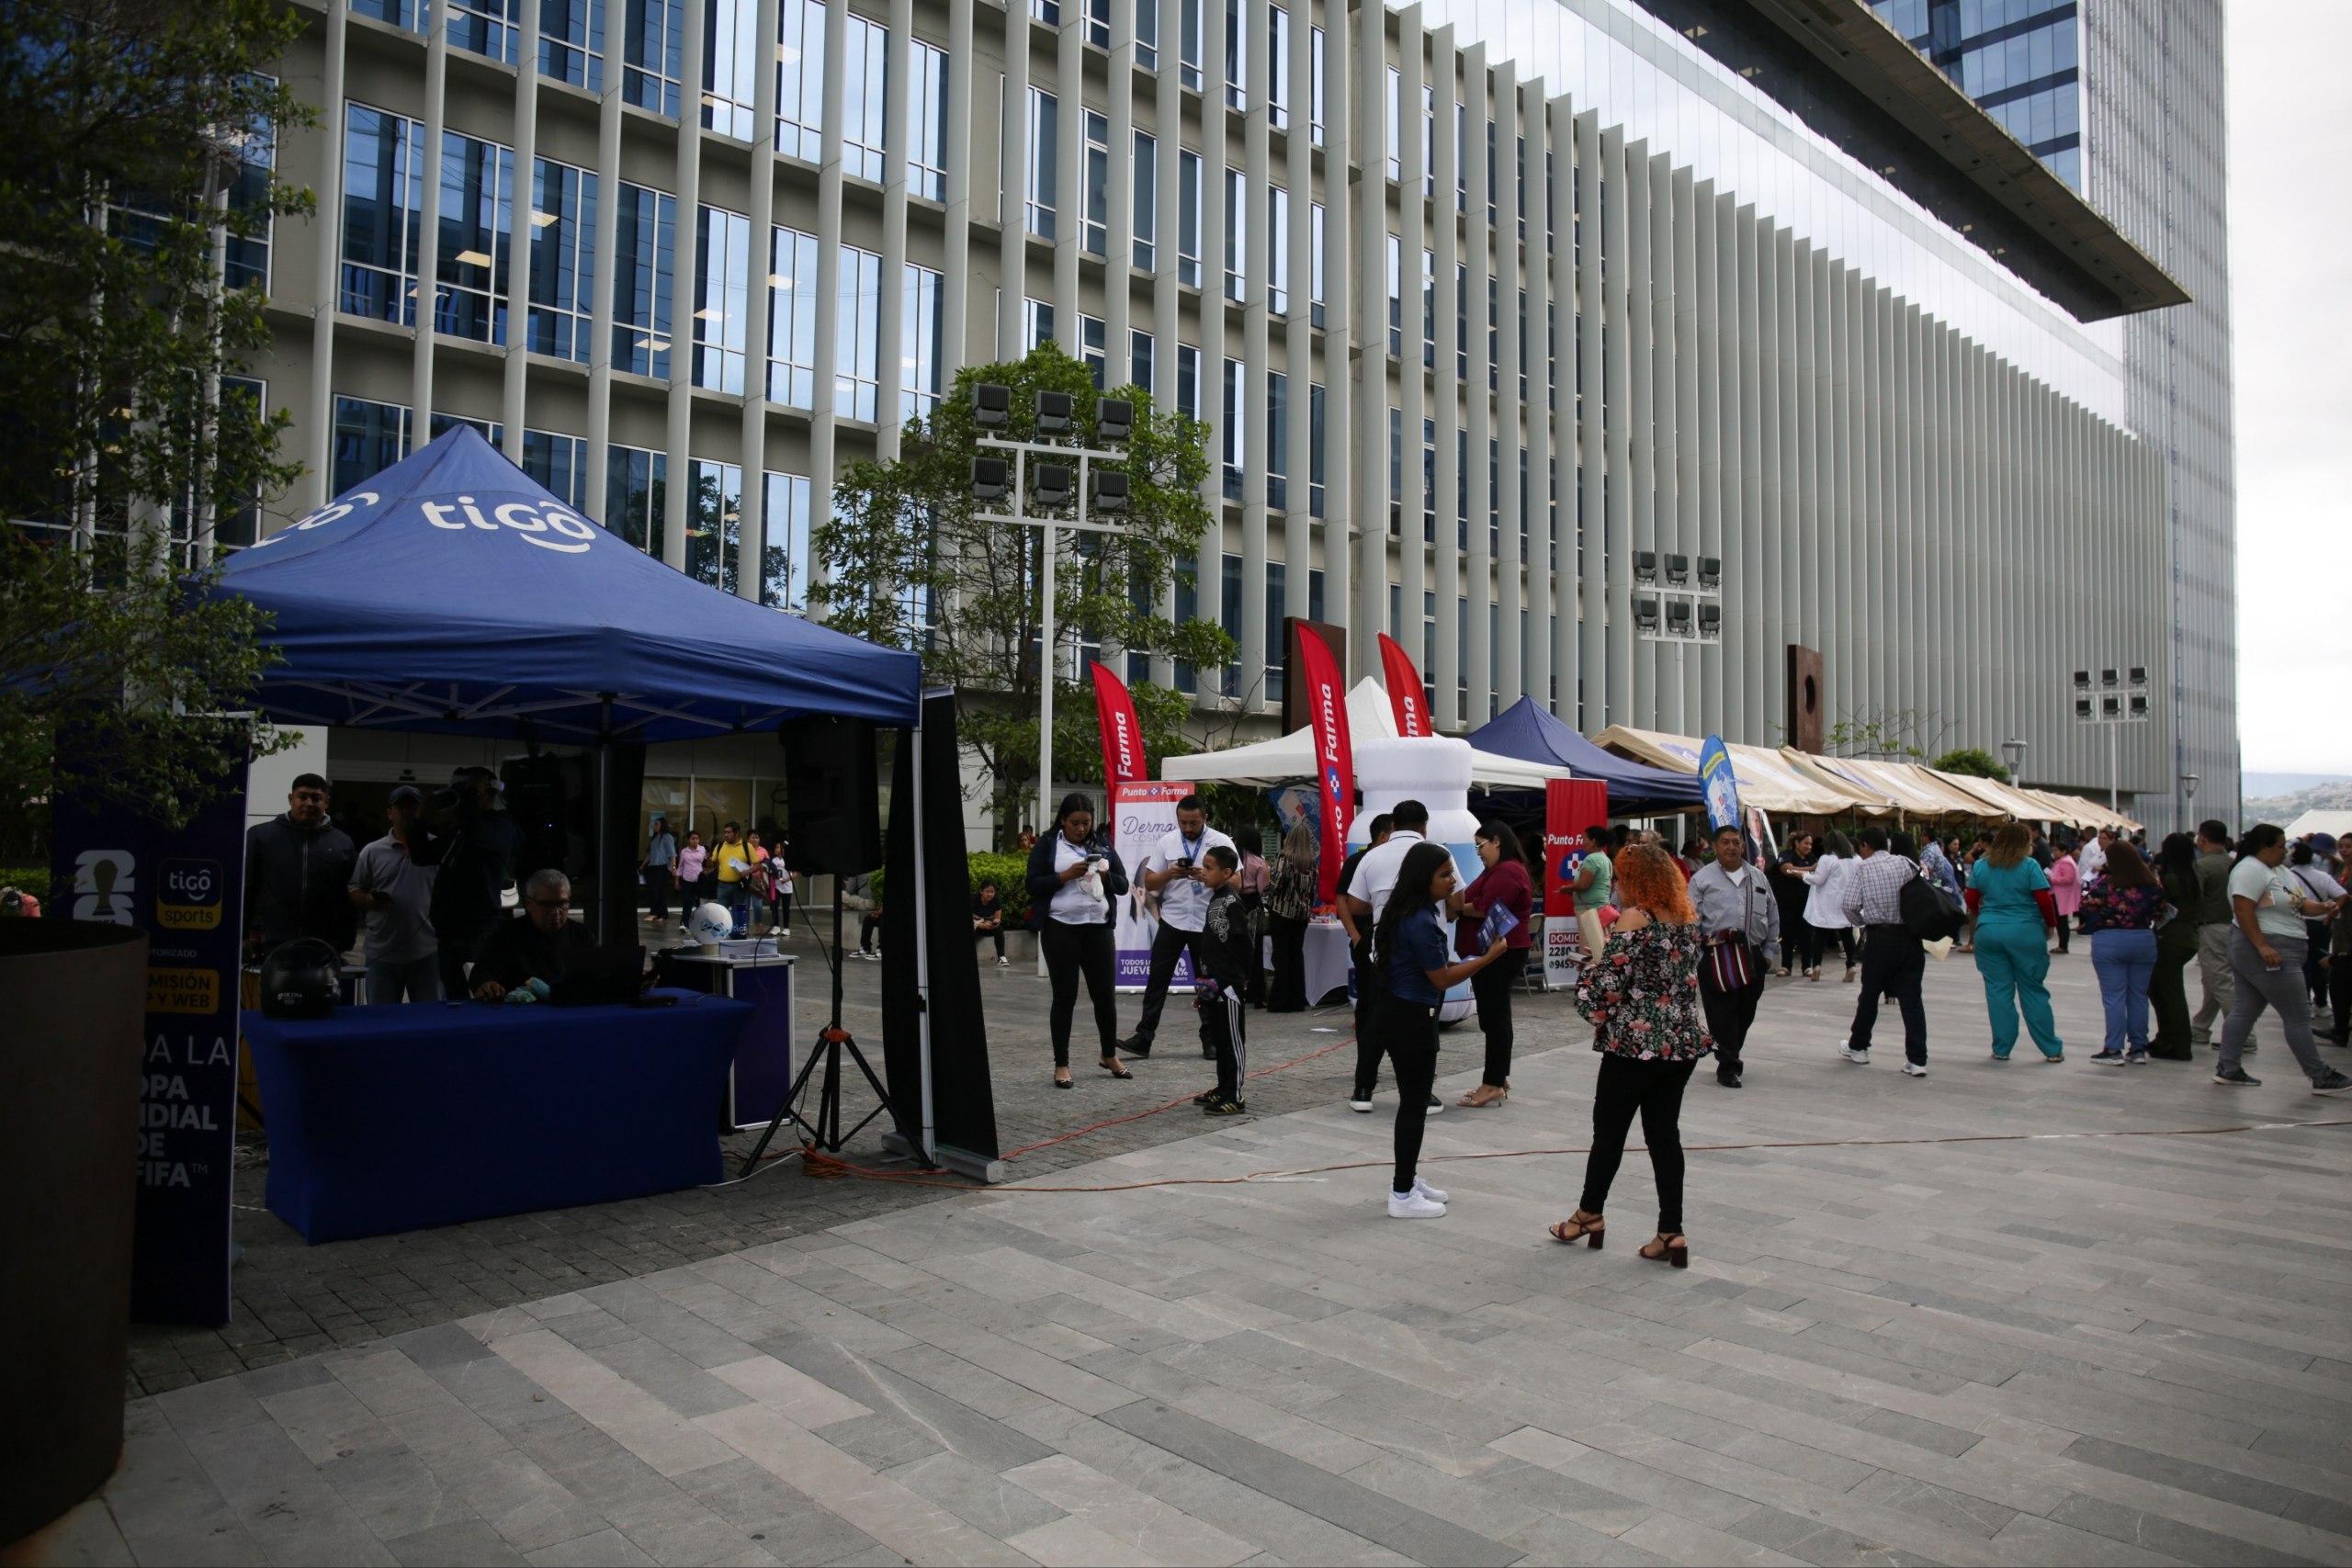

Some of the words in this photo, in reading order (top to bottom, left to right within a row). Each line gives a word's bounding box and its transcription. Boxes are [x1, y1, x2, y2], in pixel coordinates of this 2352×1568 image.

[421, 496, 597, 553] tigo
[1321, 682, 1339, 762] Farma
[1115, 711, 1134, 778] Farma
[1122, 787, 1148, 796] Punto
[1161, 786, 1189, 796] Farma
[1123, 816, 1177, 835] Derma
[1547, 833, 1574, 845] Punto
[169, 869, 211, 901] tigo
[164, 909, 214, 925] sports
[149, 948, 197, 958] TORIZADO
[157, 993, 168, 1007] Y
[172, 994, 210, 1009] WEB
[141, 1033, 173, 1064] A
[187, 1034, 231, 1066] LA
